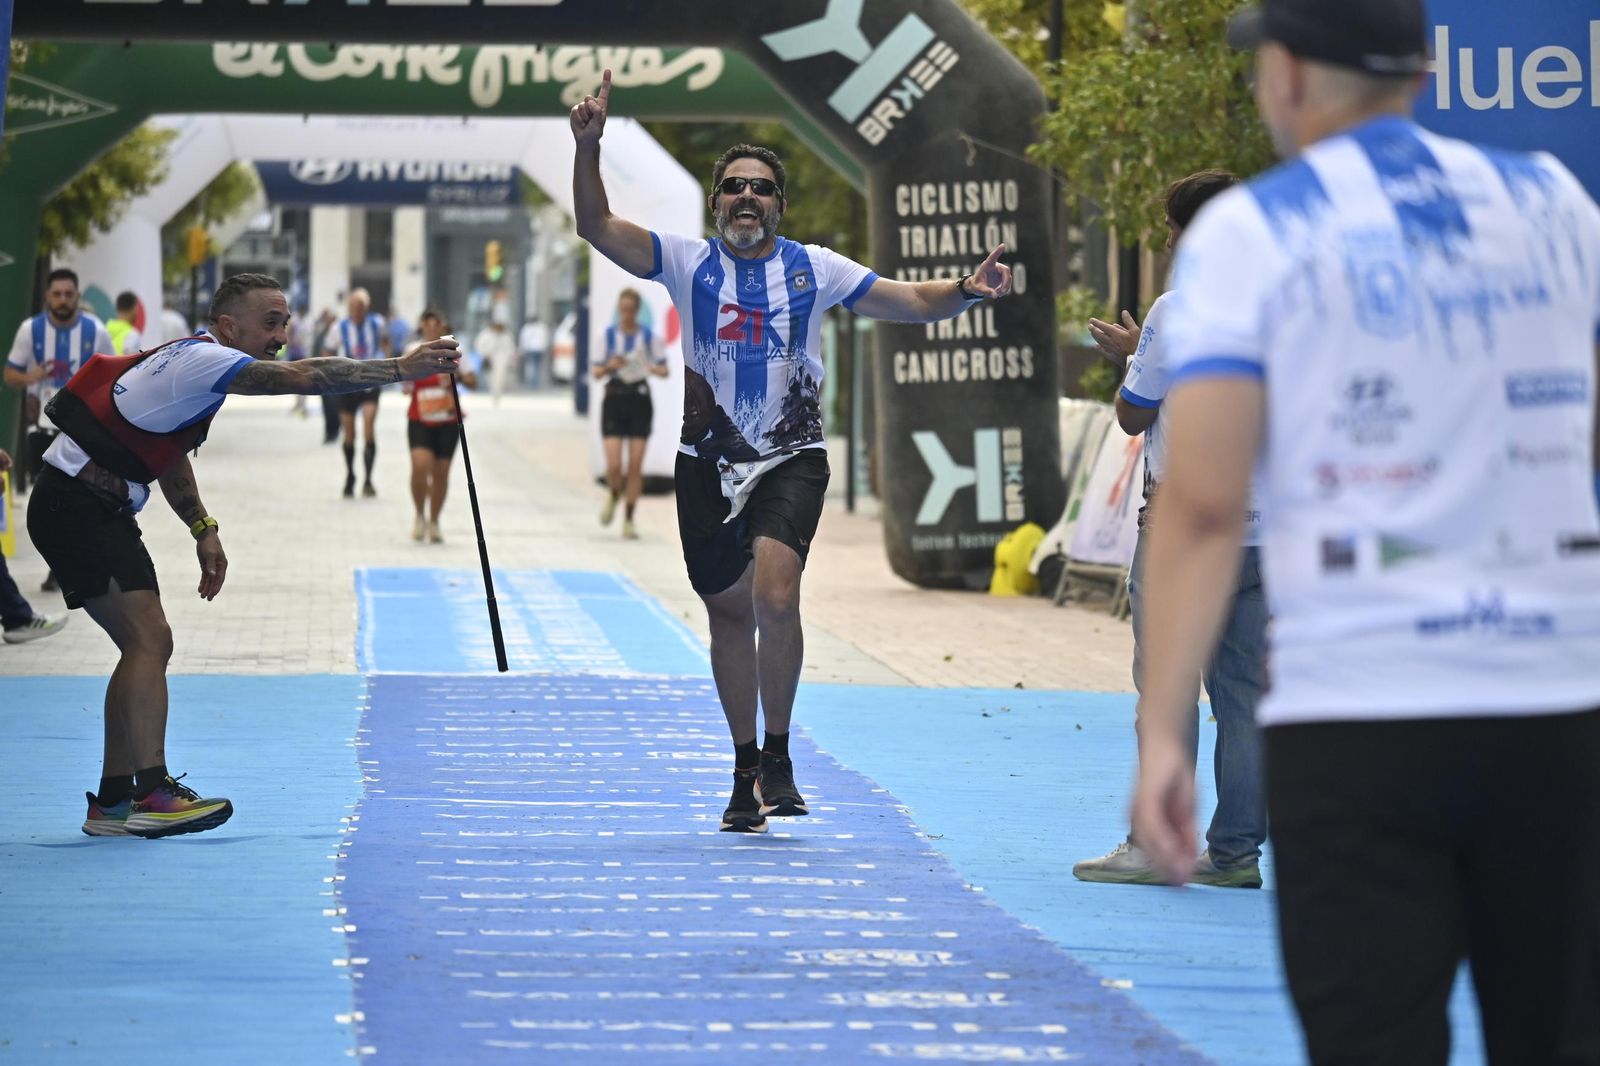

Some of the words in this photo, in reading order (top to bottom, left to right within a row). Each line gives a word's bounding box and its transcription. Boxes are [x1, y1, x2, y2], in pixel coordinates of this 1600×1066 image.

[896, 179, 1019, 217] CICLISMO
[899, 216, 1018, 258] TRIATLÓN
[718, 303, 786, 347] 21K
[894, 346, 1034, 384] CANICROSS
